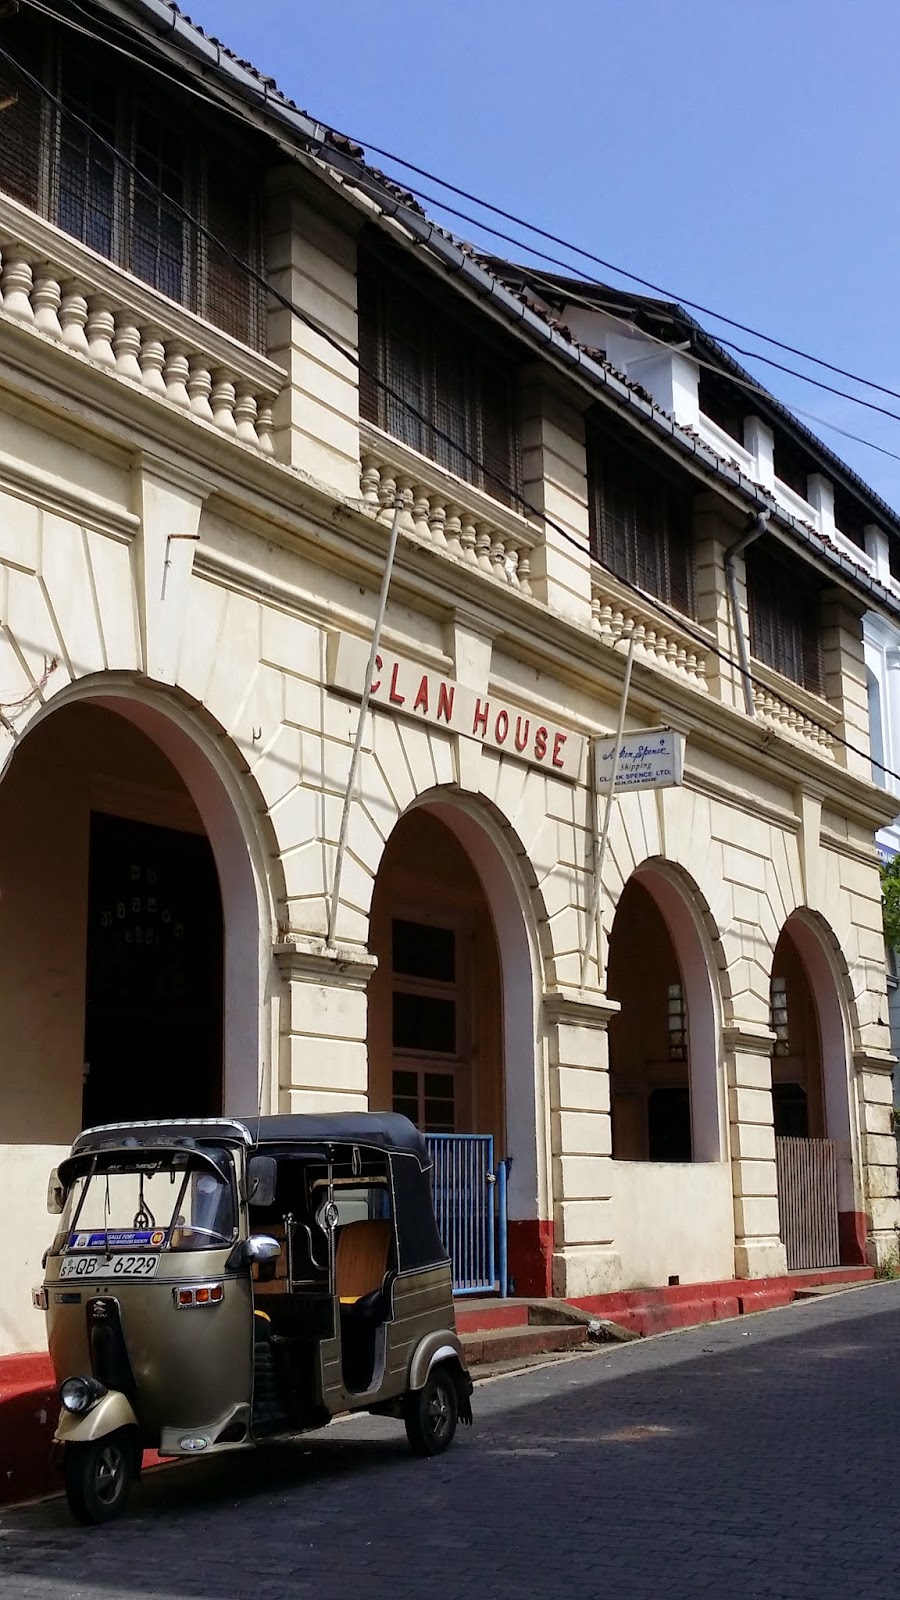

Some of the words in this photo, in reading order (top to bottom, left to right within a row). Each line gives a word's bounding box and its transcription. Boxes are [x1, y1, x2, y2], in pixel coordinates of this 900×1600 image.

[370, 654, 455, 724] CLAN
[472, 698, 568, 768] HOUSE
[620, 762, 652, 772] Shipping
[625, 771, 652, 780] SPENCE
